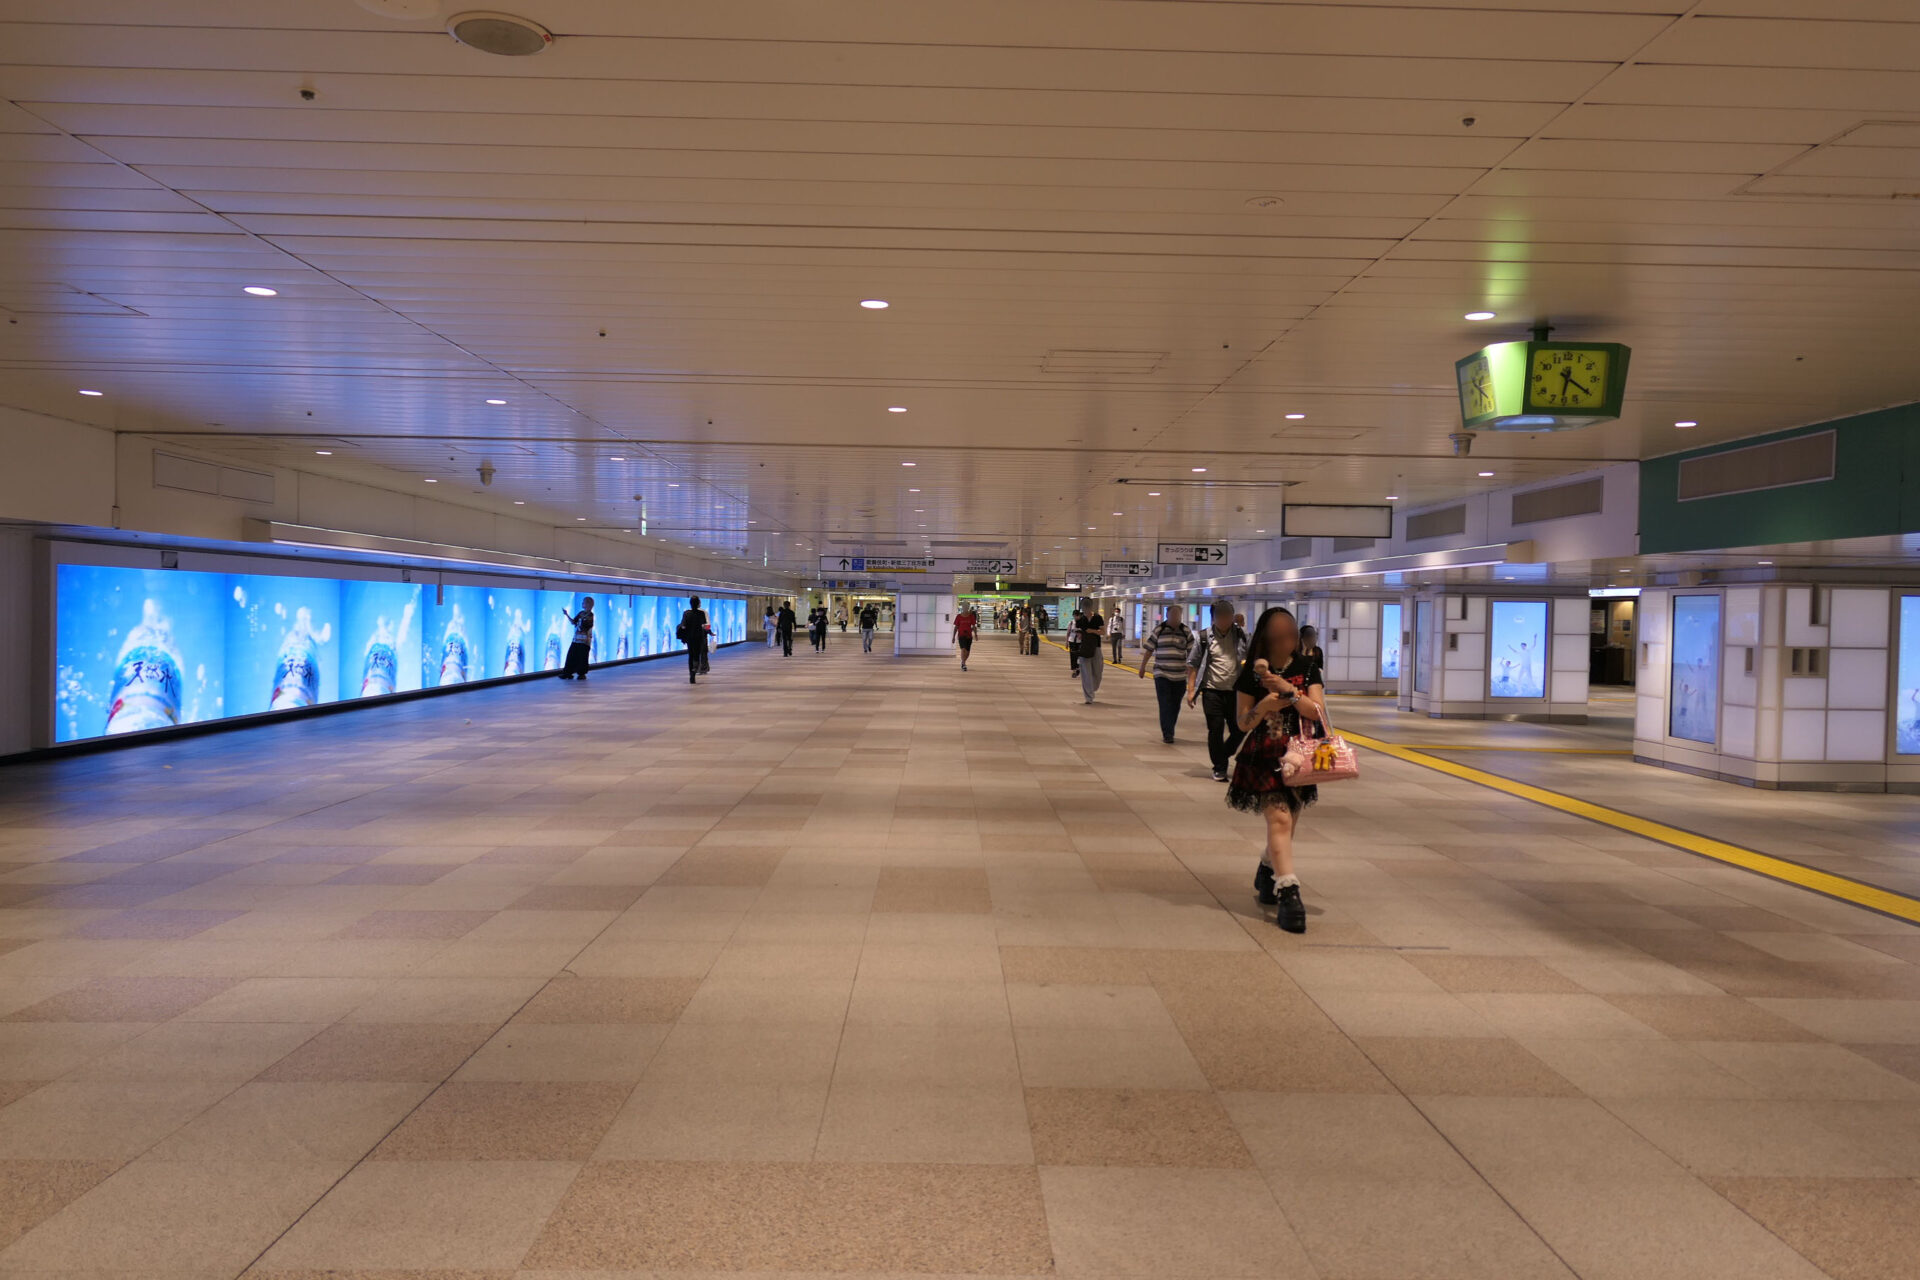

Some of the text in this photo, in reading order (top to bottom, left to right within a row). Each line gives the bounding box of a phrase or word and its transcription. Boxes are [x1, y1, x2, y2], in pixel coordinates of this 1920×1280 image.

[1553, 356, 1561, 364] 11
[1563, 352, 1573, 361] 12
[125, 661, 177, 698] 天然水
